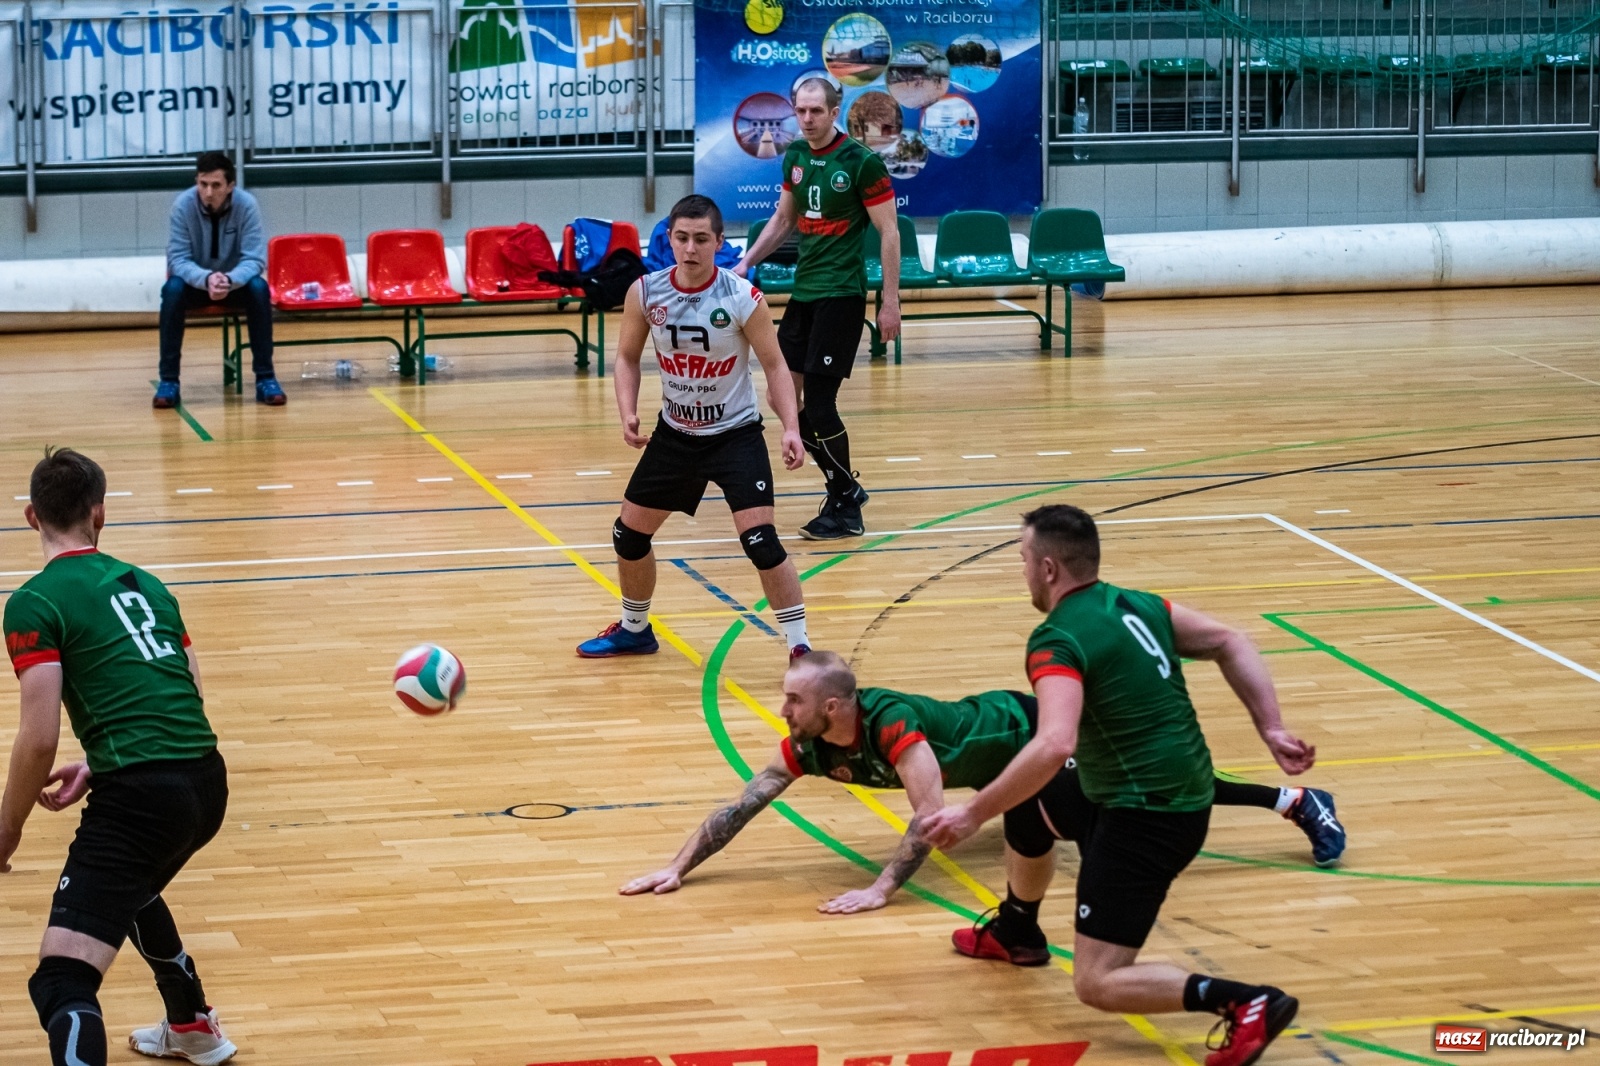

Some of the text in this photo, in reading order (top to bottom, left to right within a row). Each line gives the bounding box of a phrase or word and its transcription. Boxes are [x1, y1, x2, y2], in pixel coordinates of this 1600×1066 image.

[905, 11, 993, 24] w Raciborzu
[19, 2, 399, 63] RACIBORSKI
[268, 79, 406, 118] gramy
[537, 107, 588, 120] oaza
[808, 185, 821, 211] 13
[665, 324, 710, 352] 17
[668, 380, 717, 393] GRUPA PBG
[110, 591, 177, 661] 12
[1122, 614, 1171, 680] 9
